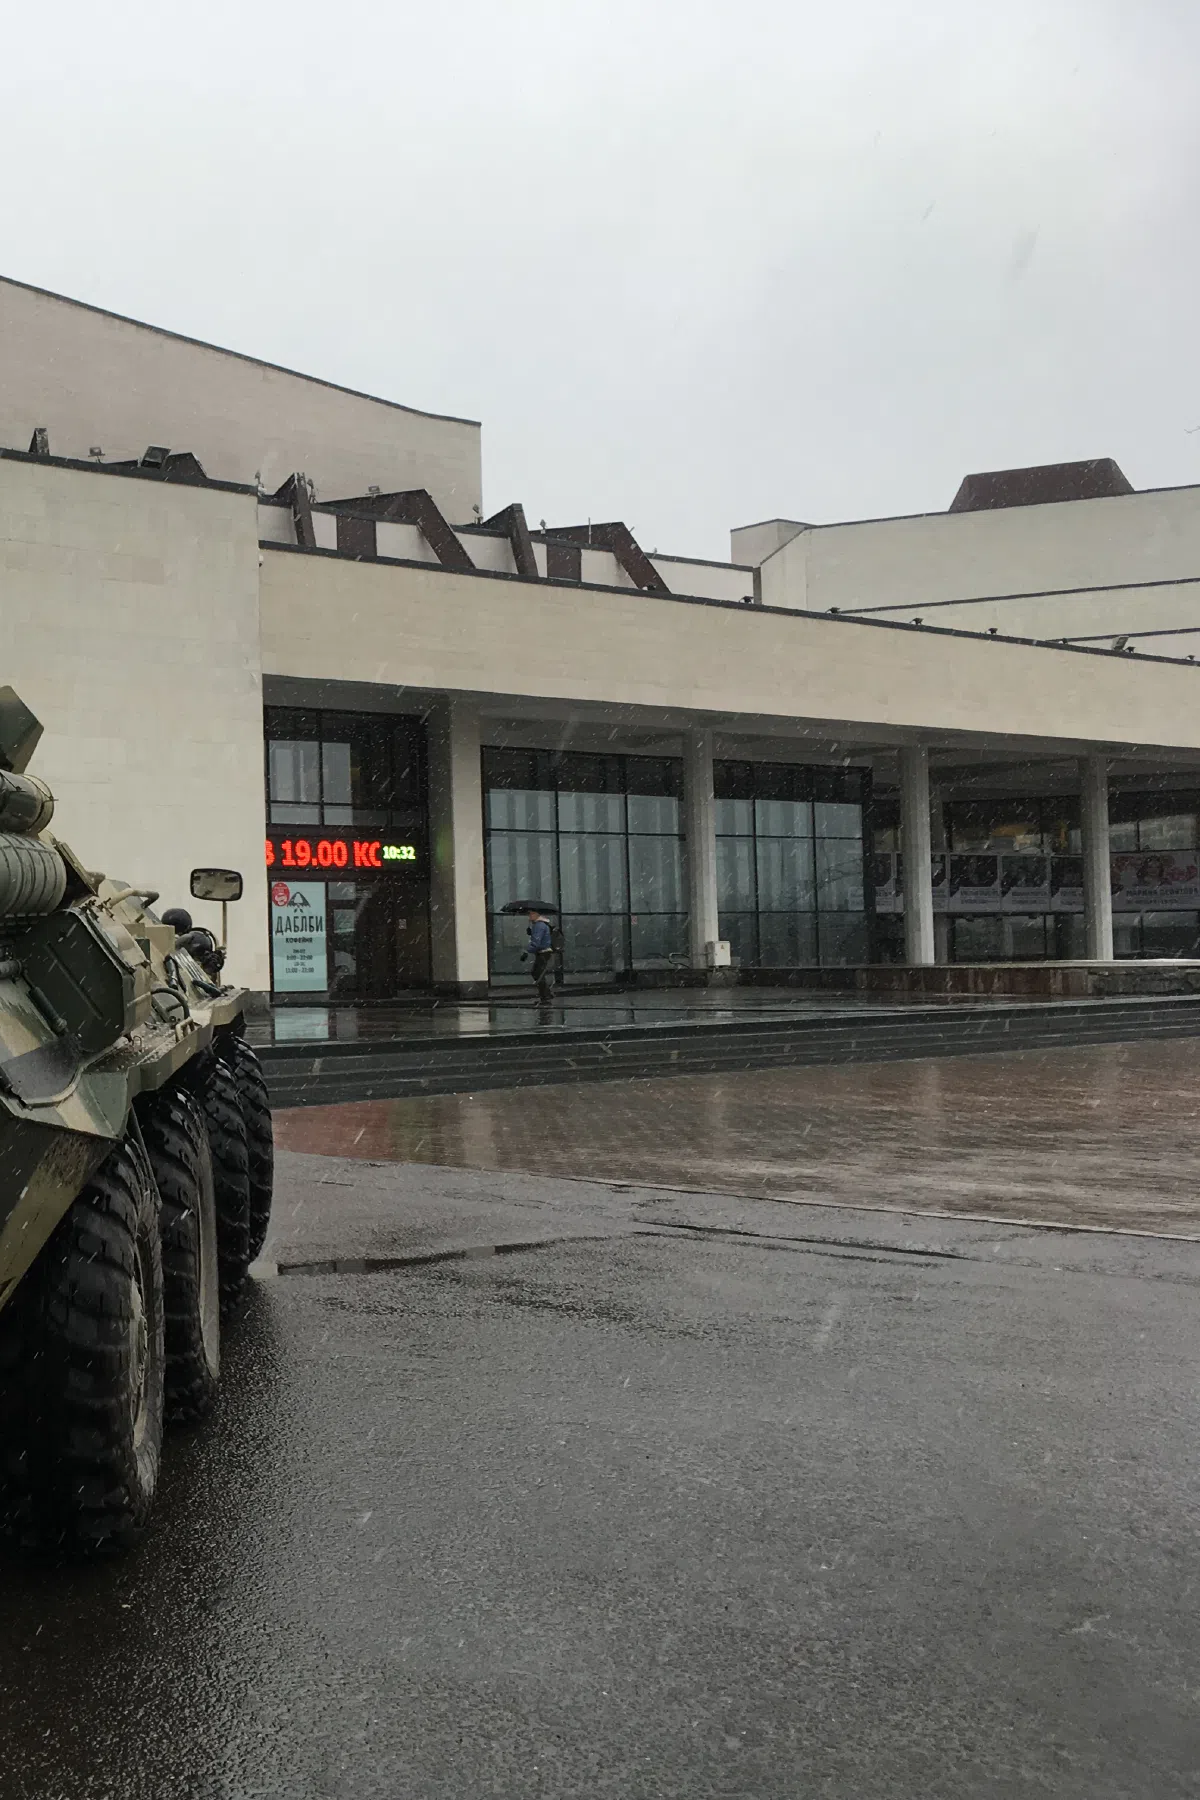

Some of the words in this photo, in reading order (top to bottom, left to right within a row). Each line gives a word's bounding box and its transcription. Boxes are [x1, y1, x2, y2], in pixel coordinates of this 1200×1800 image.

[281, 839, 348, 867] 19.00
[382, 845, 416, 860] 10:32
[275, 915, 323, 935] ДАБЛБИ
